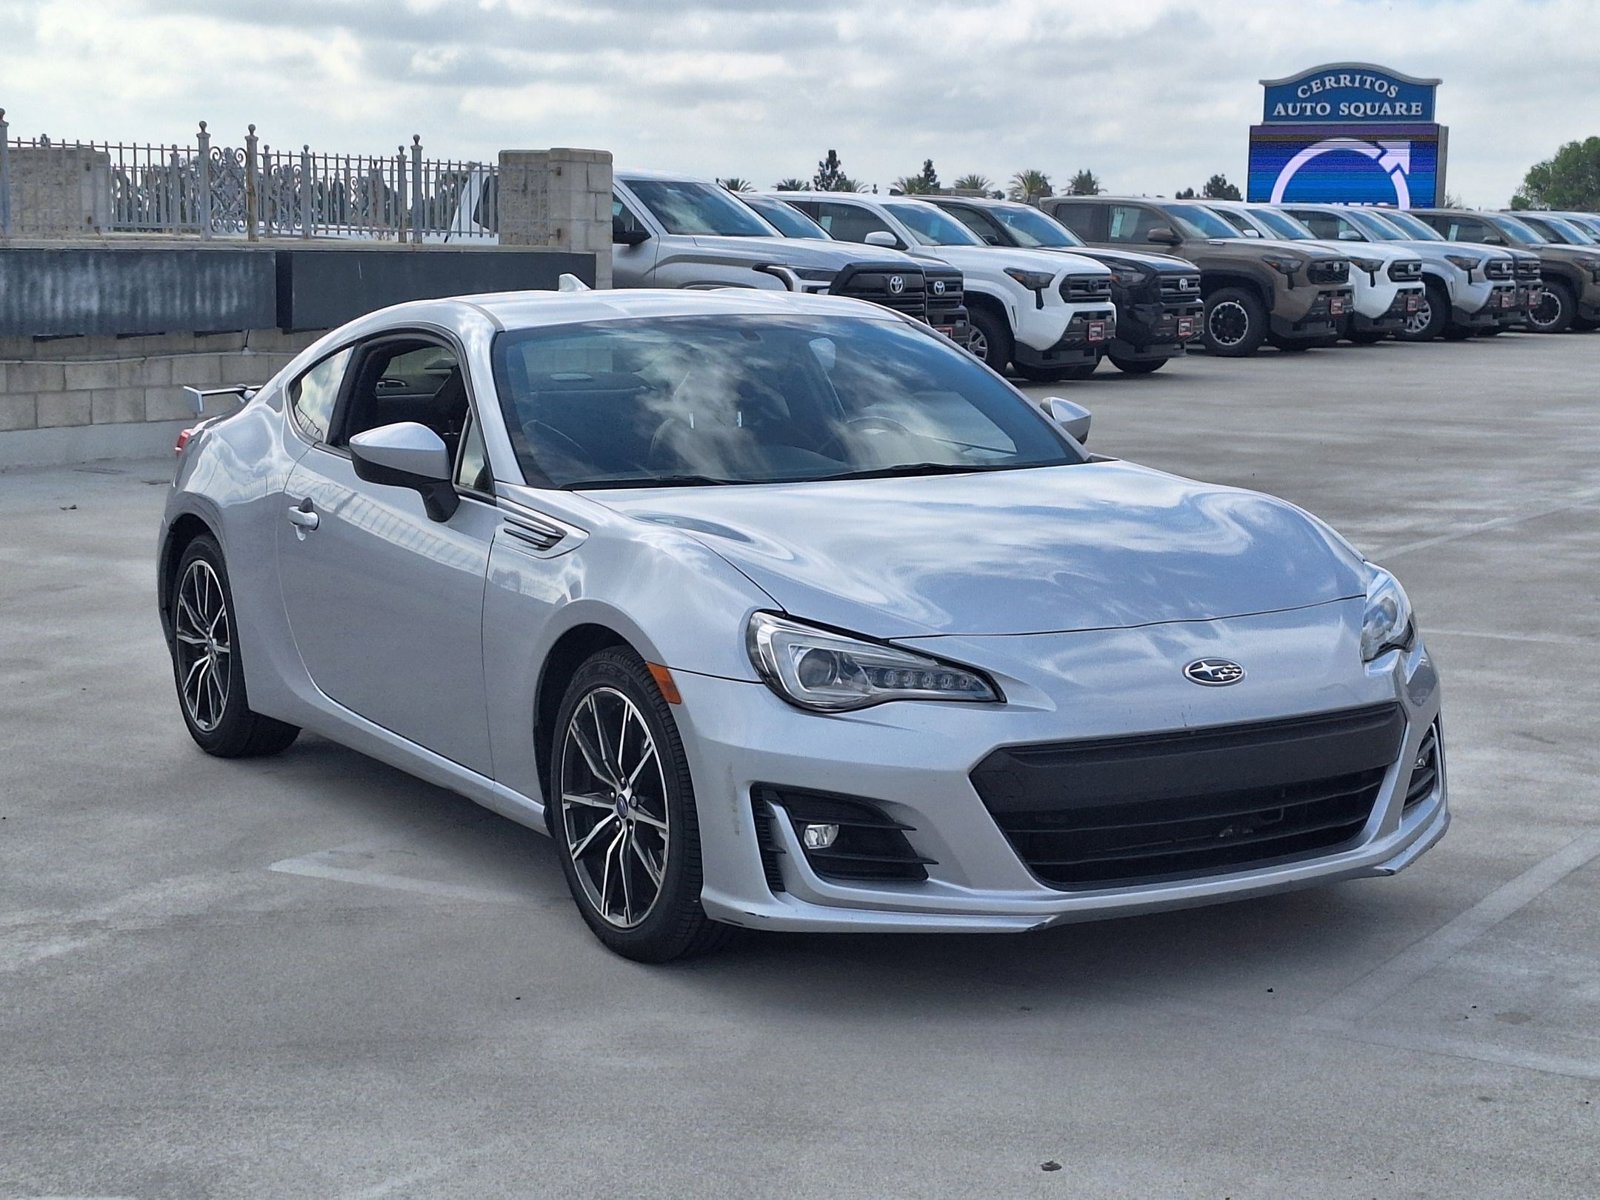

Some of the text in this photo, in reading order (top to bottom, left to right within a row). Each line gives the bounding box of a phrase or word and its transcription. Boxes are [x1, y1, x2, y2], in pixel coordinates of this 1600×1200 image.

[1297, 74, 1399, 98] CERRITOS
[1273, 102, 1423, 117] AUTO SQUARE
